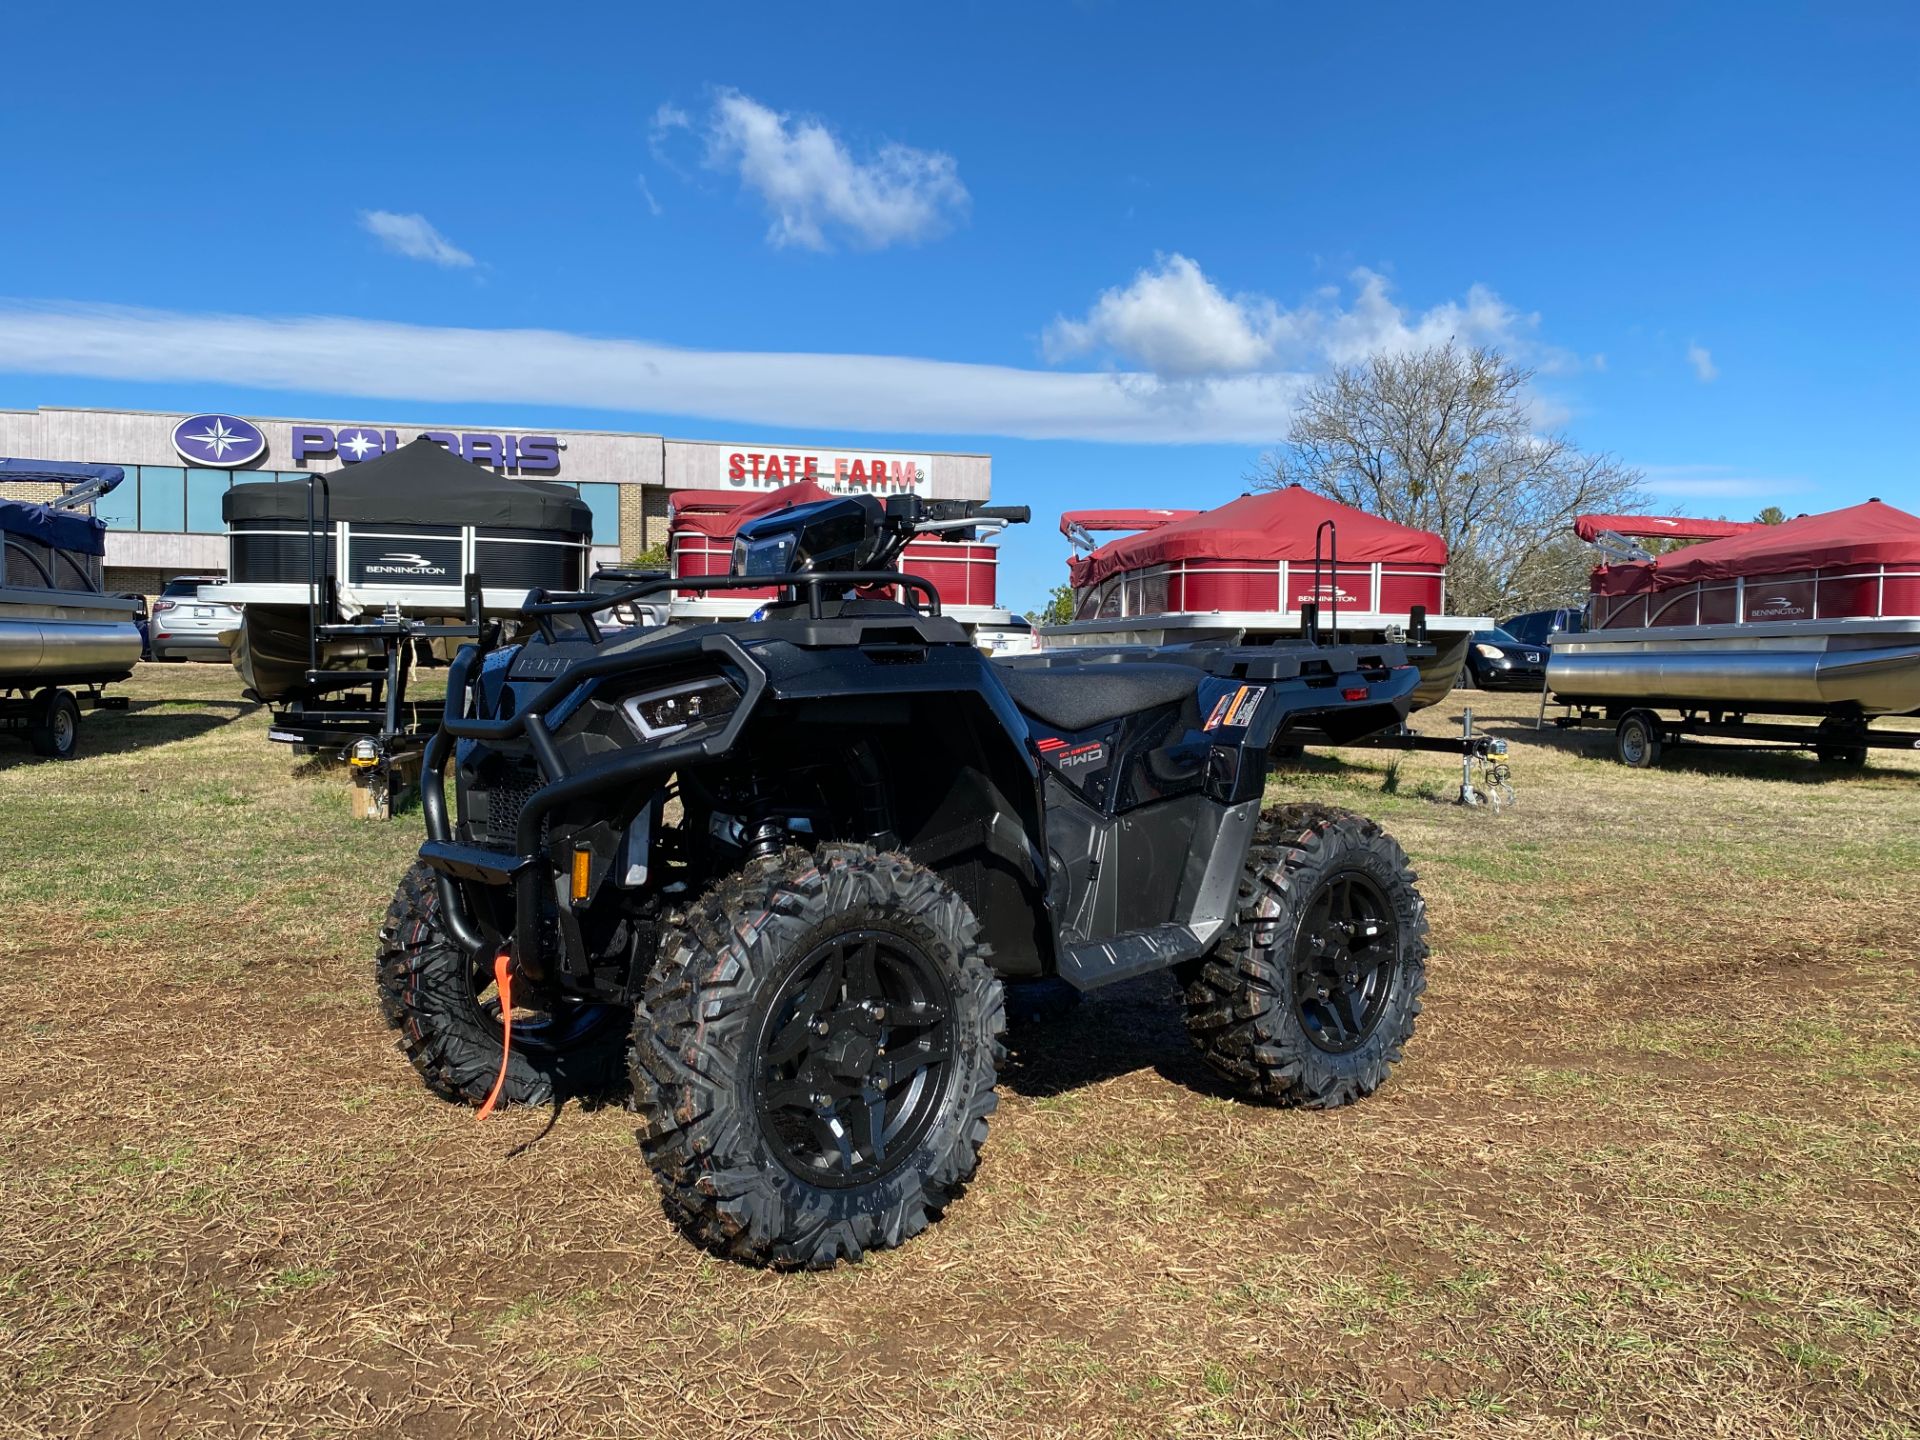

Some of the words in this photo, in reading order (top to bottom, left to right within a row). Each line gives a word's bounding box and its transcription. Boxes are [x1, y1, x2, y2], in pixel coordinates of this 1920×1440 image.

[728, 453, 818, 481] STATE
[835, 458, 916, 487] FARM
[365, 565, 446, 575] BENNINGTON
[1751, 606, 1805, 617] BENNINGTON
[1059, 748, 1103, 769] AWD
